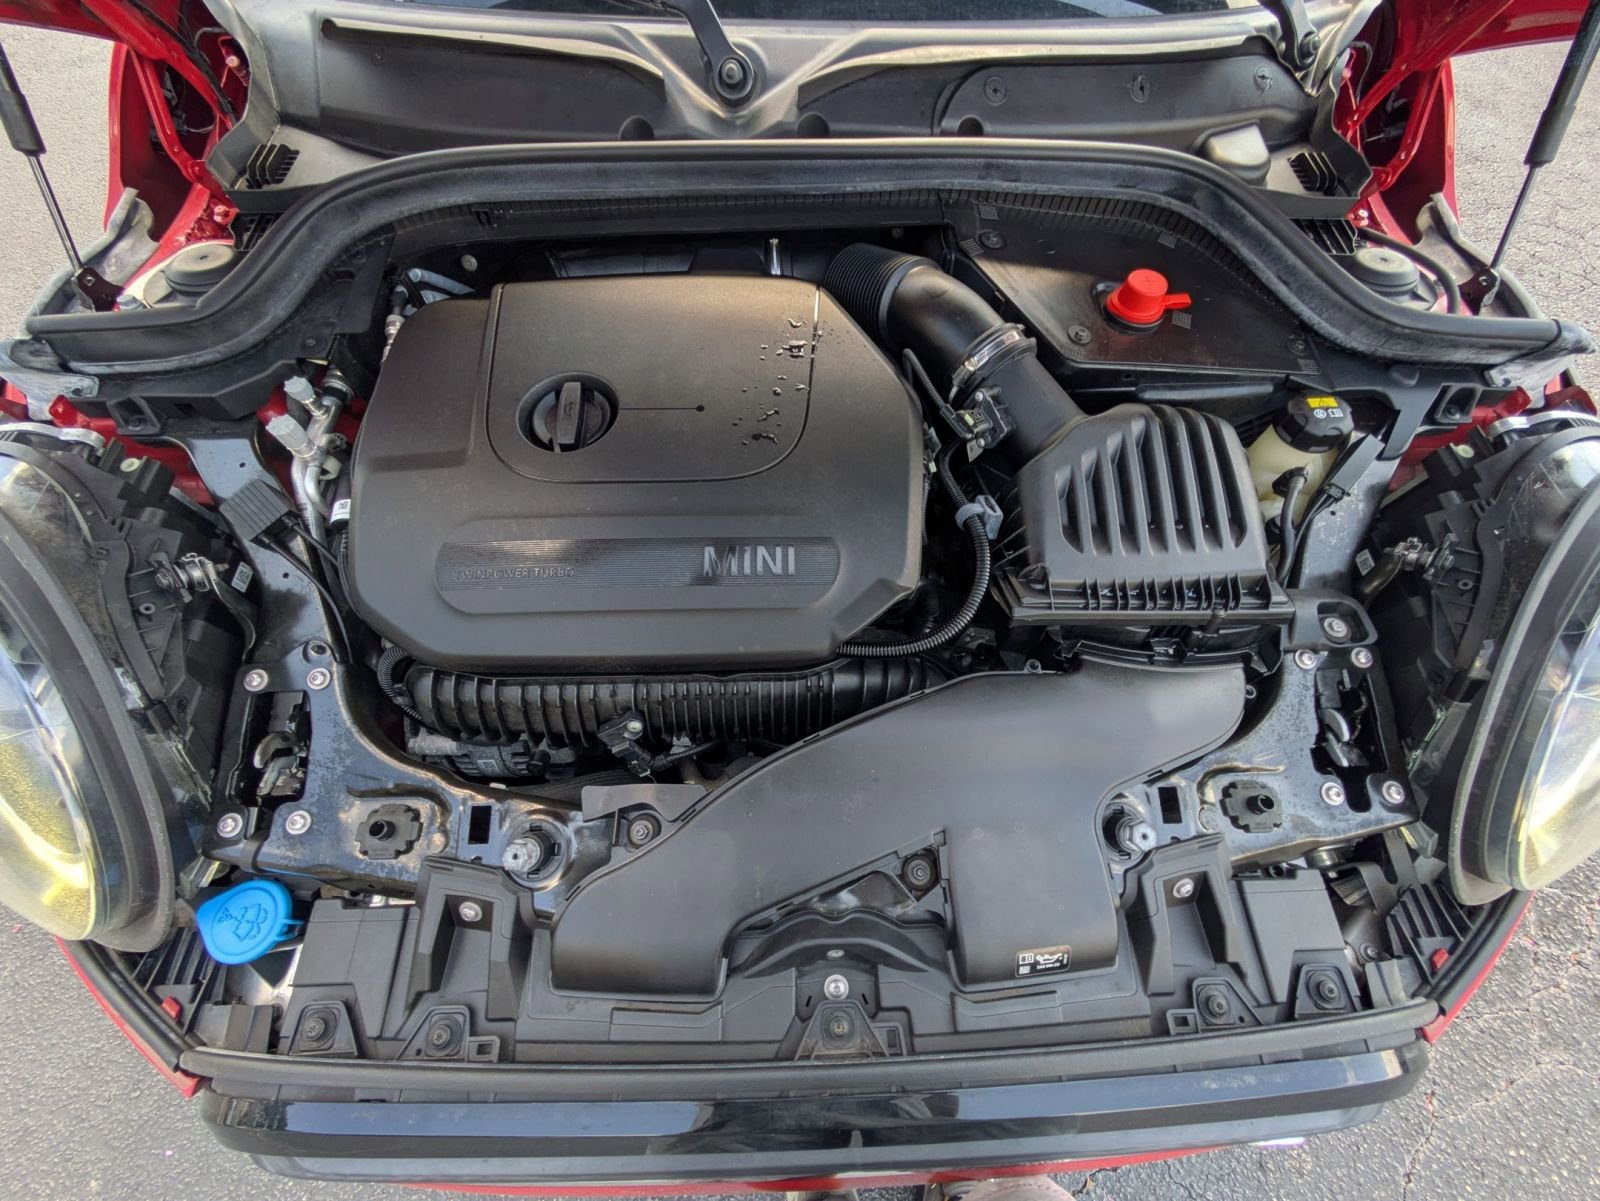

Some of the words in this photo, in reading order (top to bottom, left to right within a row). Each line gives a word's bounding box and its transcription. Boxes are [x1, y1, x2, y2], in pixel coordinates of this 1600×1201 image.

[703, 545, 796, 576] MINI
[455, 567, 530, 580] TWINPOWER
[533, 566, 577, 578] TURBO
